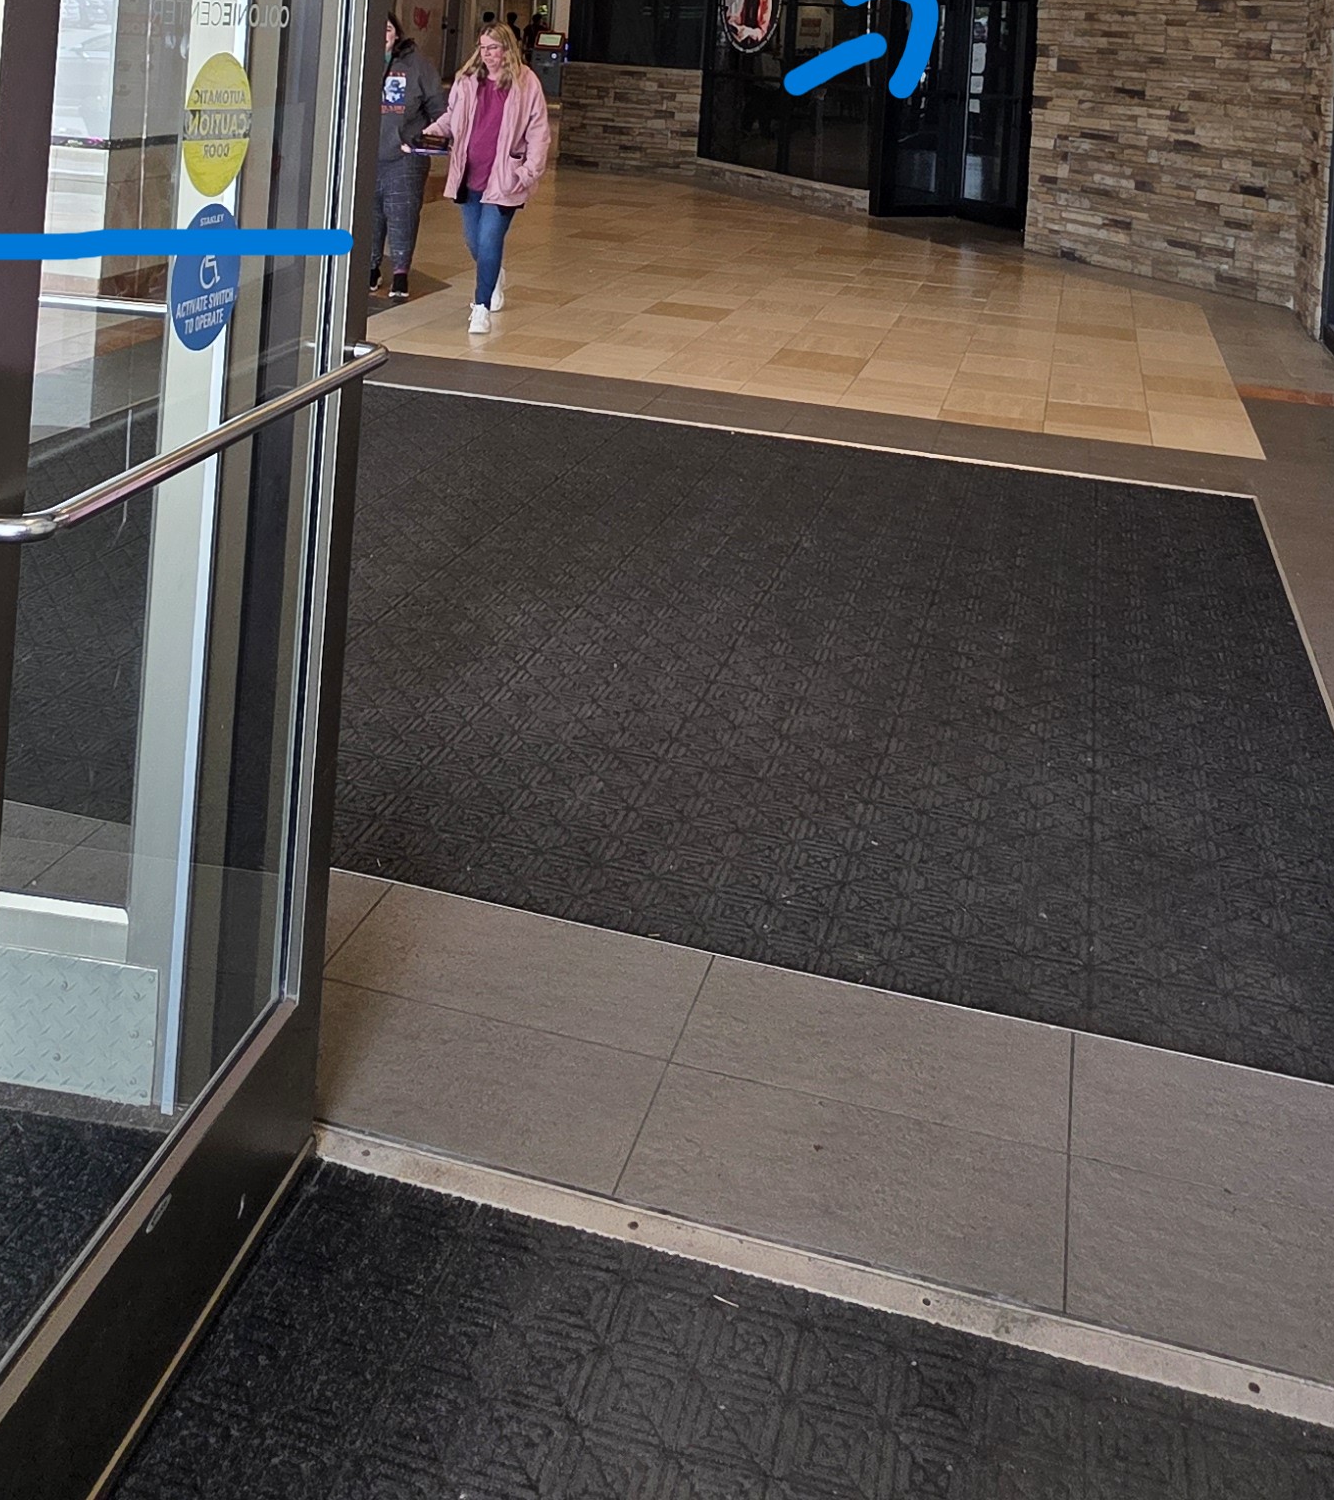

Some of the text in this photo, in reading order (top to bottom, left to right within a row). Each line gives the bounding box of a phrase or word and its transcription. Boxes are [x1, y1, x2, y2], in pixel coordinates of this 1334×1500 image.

[175, 287, 235, 320] ACTIVATE SWITCH
[184, 308, 224, 335] TO OPERATE
